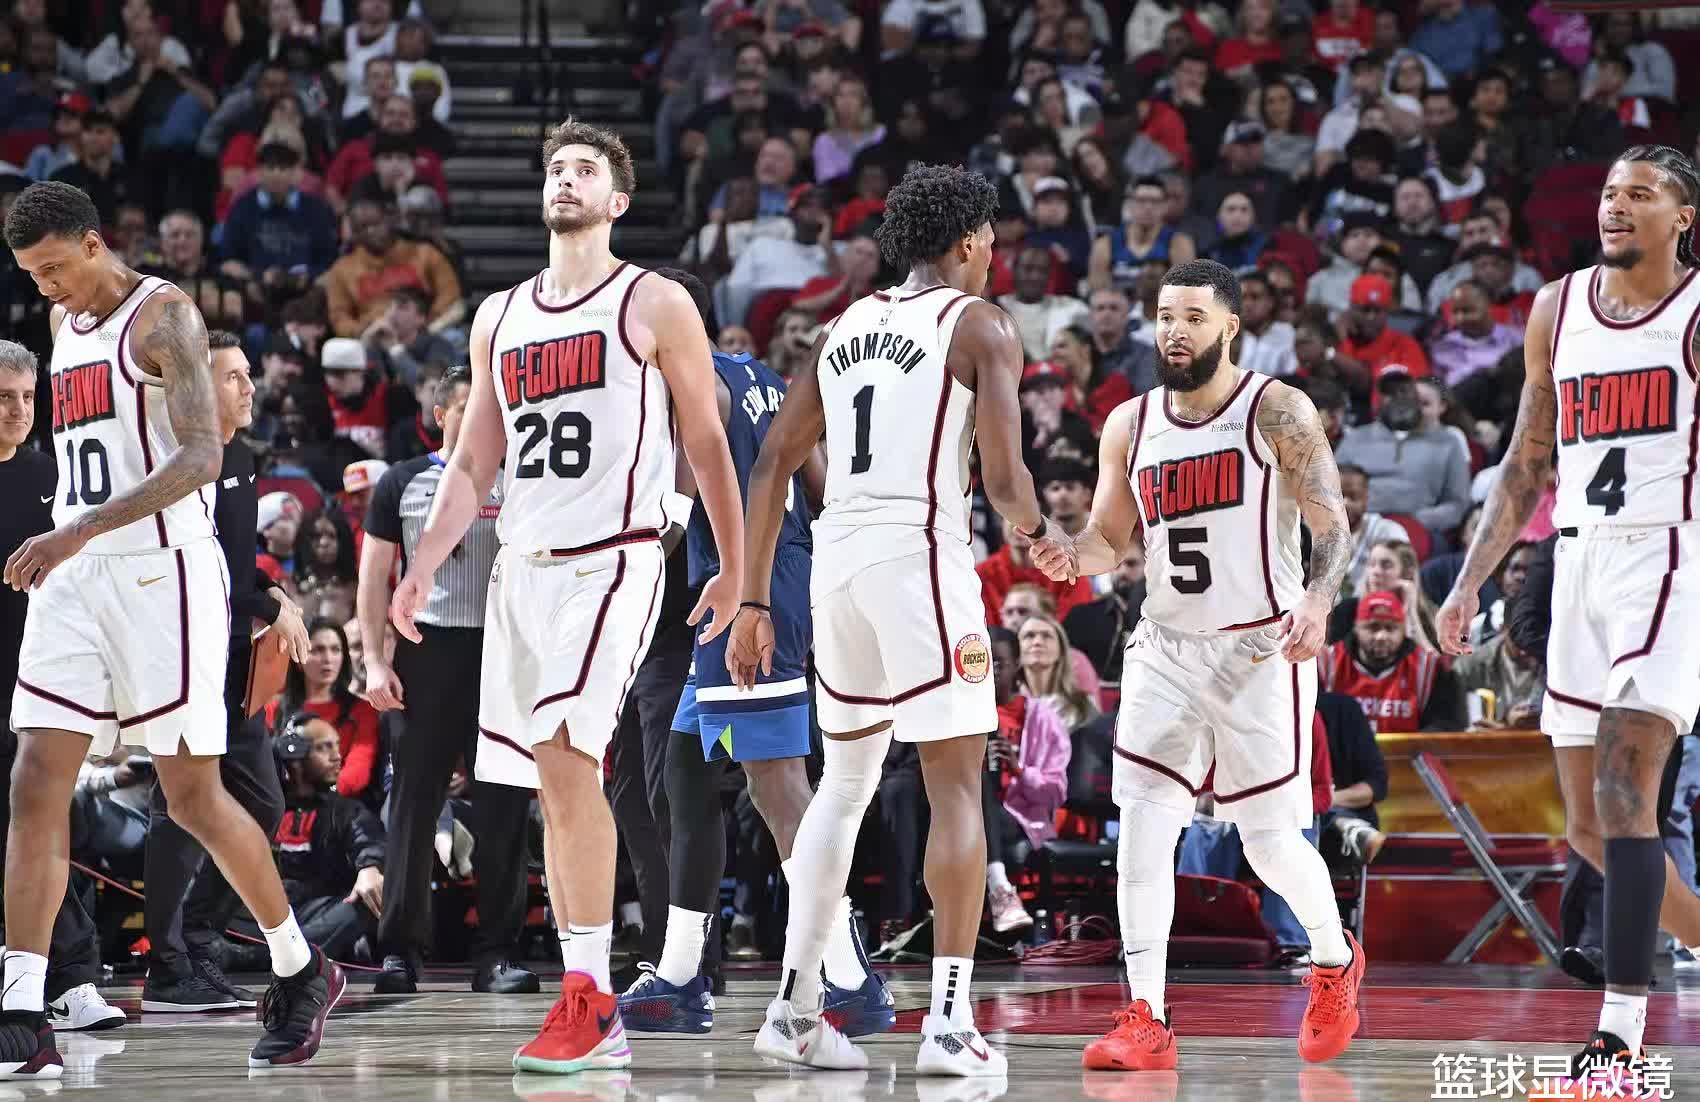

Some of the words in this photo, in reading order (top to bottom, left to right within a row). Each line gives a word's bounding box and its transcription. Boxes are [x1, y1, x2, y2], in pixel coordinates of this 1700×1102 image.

[827, 332, 927, 376] THOMPSON
[742, 385, 784, 425] EDWAR
[850, 385, 875, 475] 1
[66, 438, 112, 506] 10
[514, 411, 592, 479] 28
[1585, 447, 1627, 516] 4
[1168, 527, 1212, 594] 5
